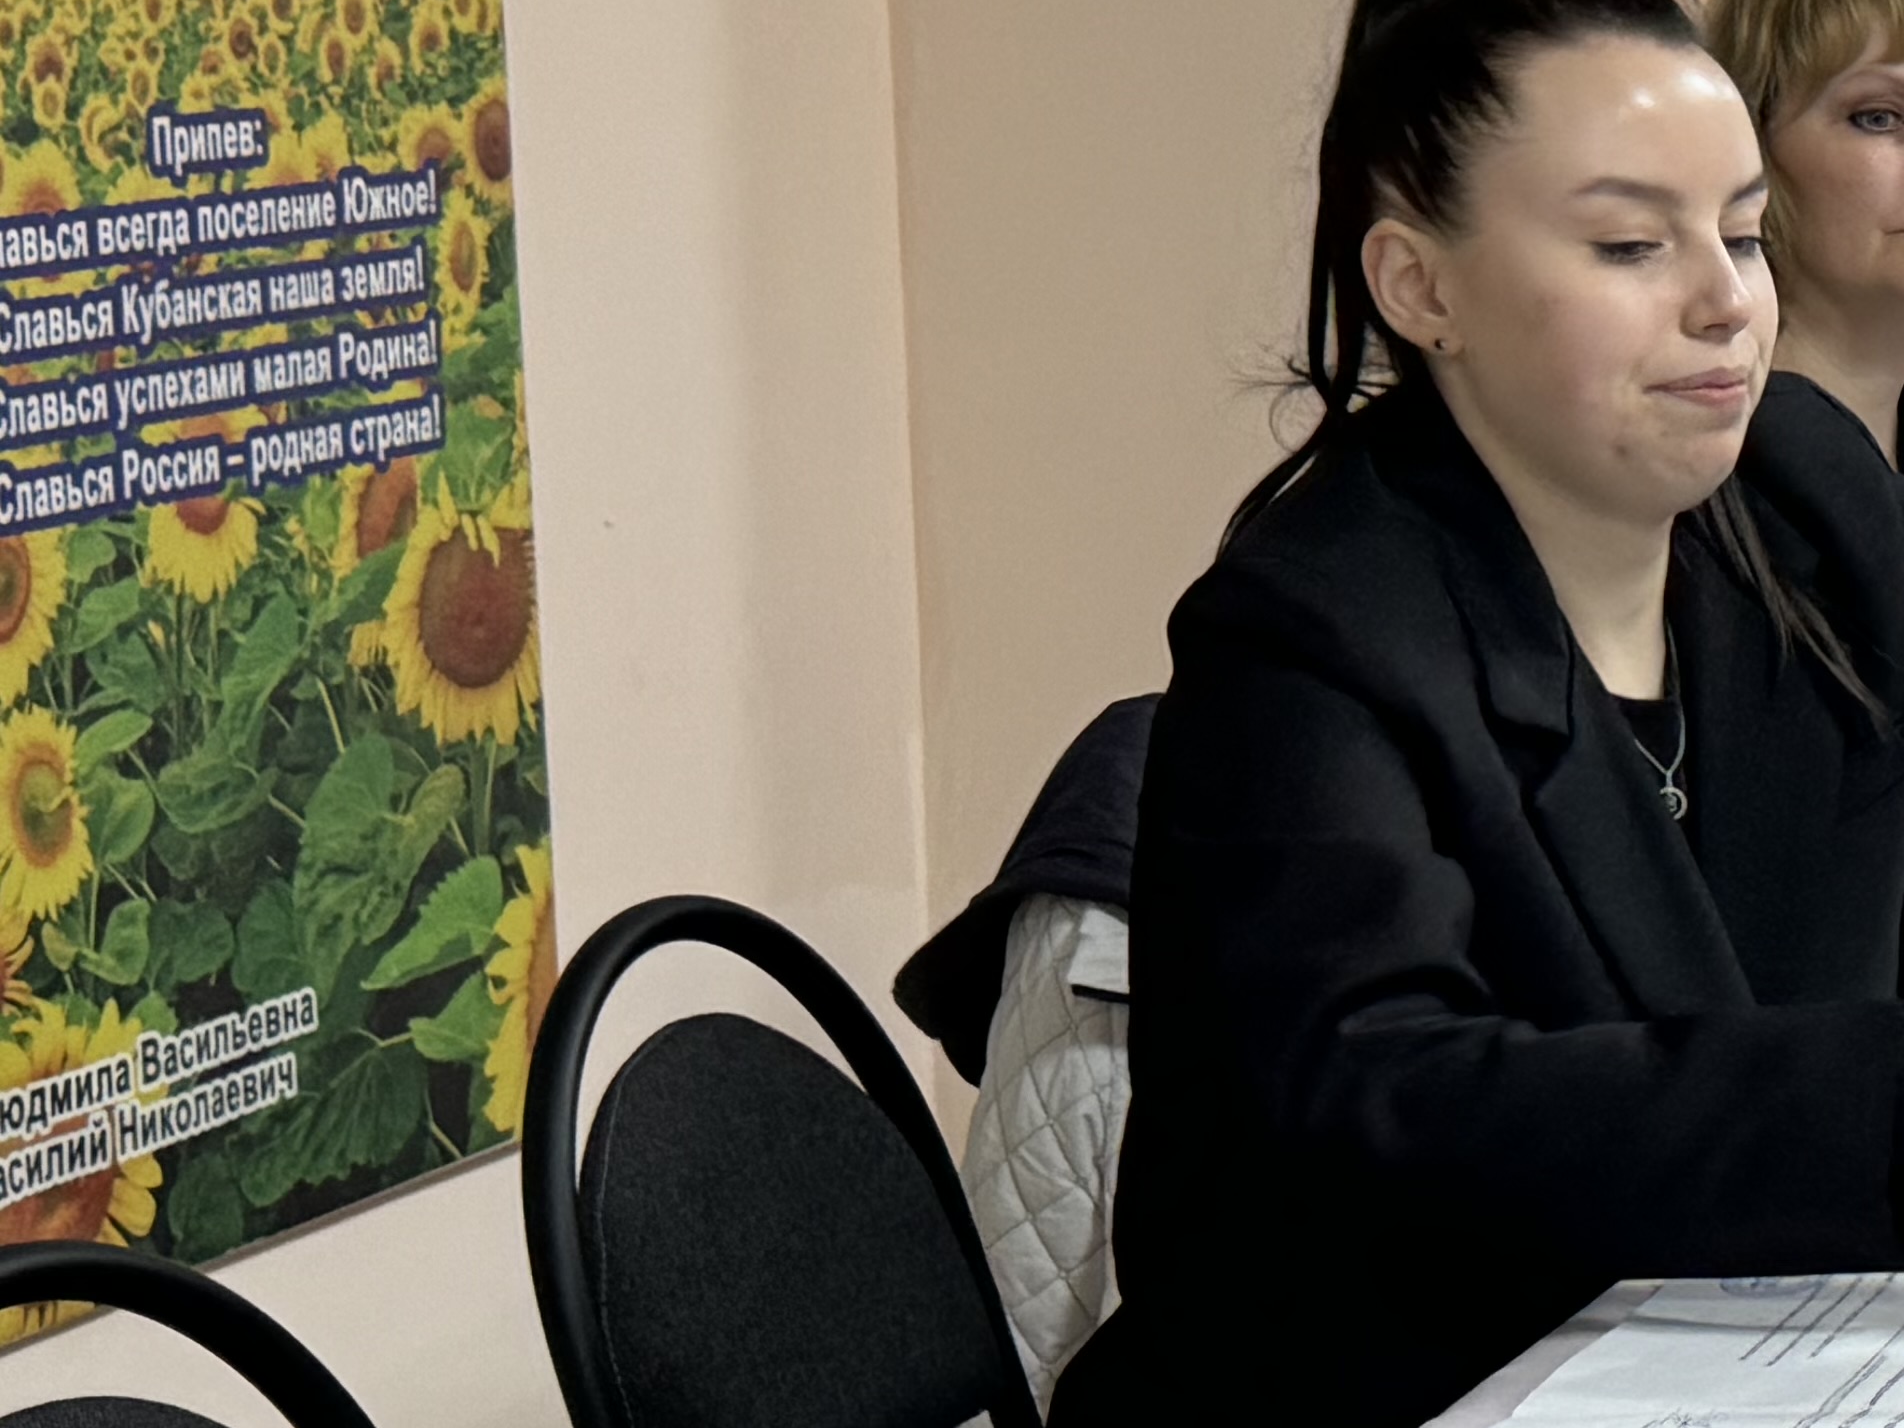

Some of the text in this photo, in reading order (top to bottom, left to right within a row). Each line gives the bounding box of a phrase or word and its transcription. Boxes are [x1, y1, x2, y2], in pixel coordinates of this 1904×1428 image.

[150, 115, 264, 177] Припев:
[97, 207, 191, 257] всегда
[199, 188, 337, 243] поселение
[343, 169, 437, 223] Южное!
[122, 274, 263, 344] Кубанская
[269, 264, 333, 310] наша
[341, 245, 425, 301] земля!
[114, 360, 246, 430] успехами
[253, 346, 333, 403] малая
[339, 320, 438, 380] Родина!
[122, 444, 221, 500] Россия
[250, 421, 343, 487] родная
[350, 394, 441, 462] страна!
[141, 990, 316, 1086] Васильевна
[117, 1057, 295, 1157] Николаевич
